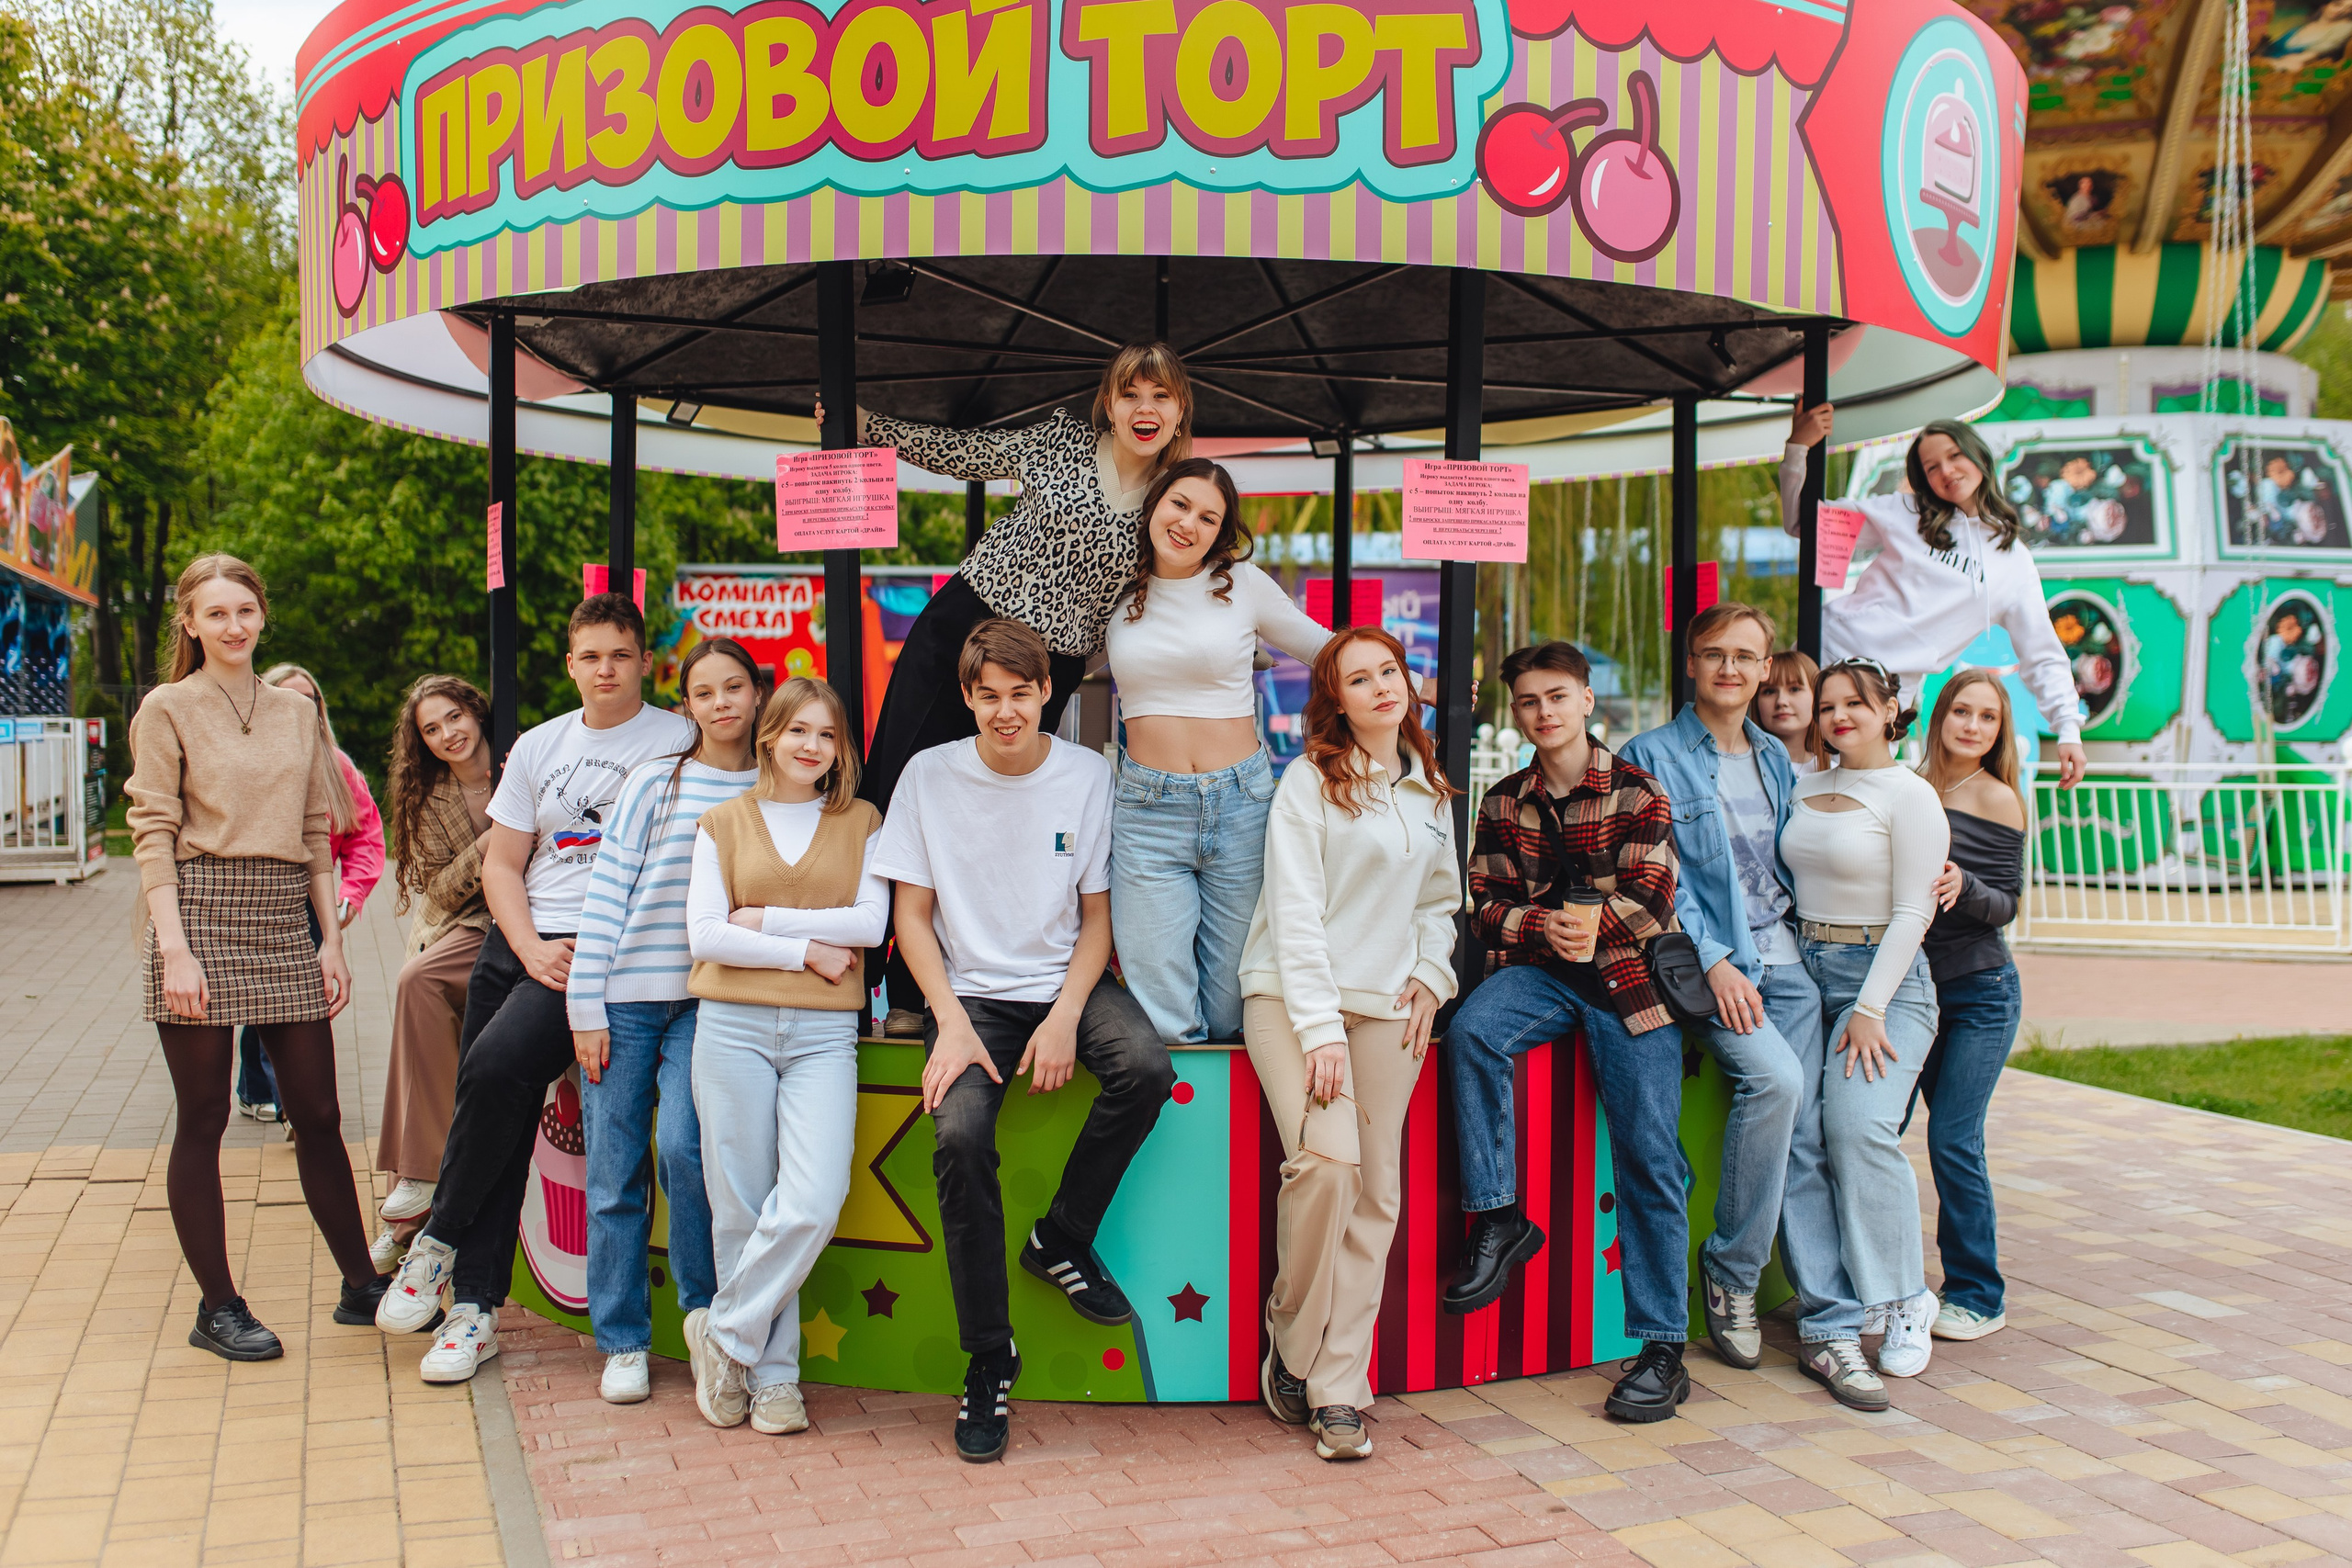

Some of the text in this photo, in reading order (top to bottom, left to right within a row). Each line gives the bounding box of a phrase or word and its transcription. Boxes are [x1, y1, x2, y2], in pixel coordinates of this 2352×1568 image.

[420, 0, 1468, 213] ПРИЗОВОЙ ТОРТ
[793, 456, 808, 464] Игра
[808, 451, 852, 461] «ПРИЗОВОЙ
[1424, 463, 1442, 471] Игра
[1442, 462, 1487, 472] «ПРИЗОВОЙ
[785, 493, 889, 506] ВЫИГРЫШ: МЯГКАЯ ИГРУШКА
[1455, 507, 1486, 515] МЯГКАЯ
[1487, 508, 1521, 516] ИГРУШКА
[678, 580, 807, 603] КОМНАТА
[698, 609, 786, 628] СМЕХА
